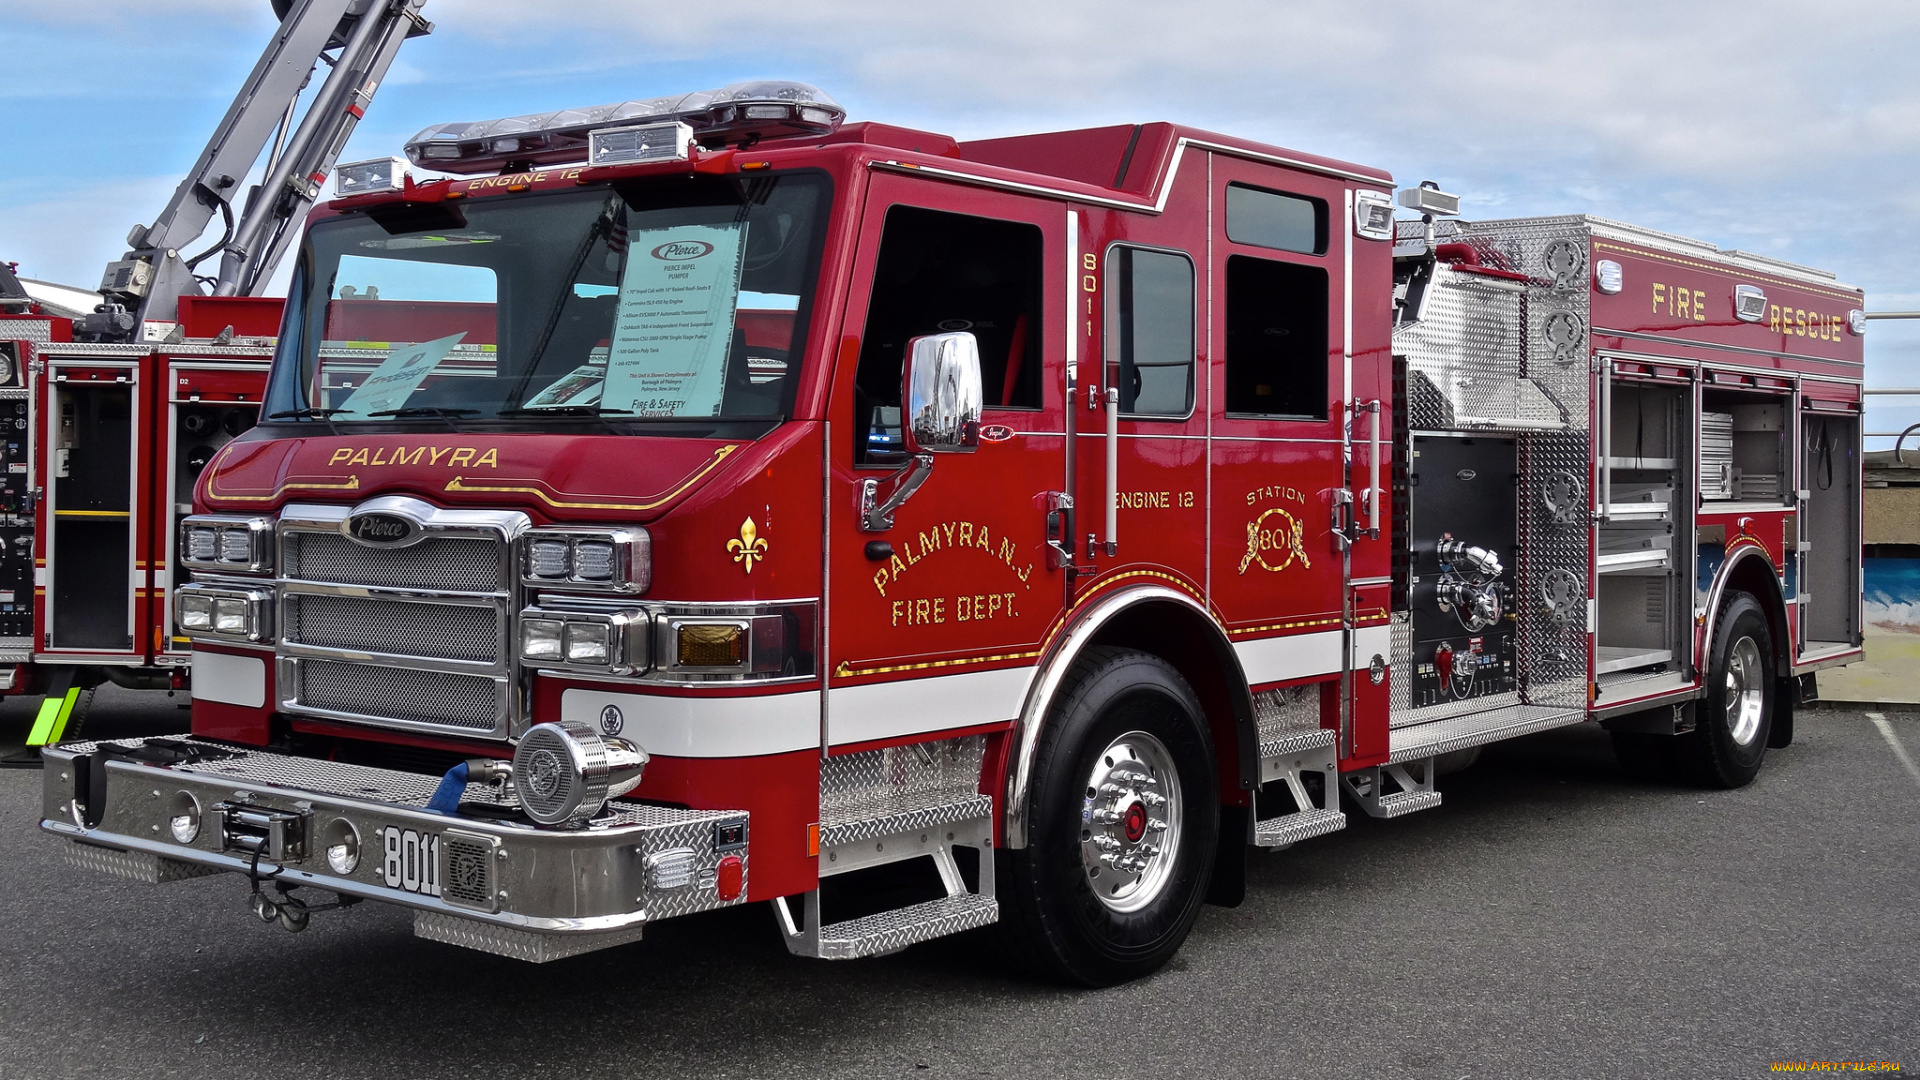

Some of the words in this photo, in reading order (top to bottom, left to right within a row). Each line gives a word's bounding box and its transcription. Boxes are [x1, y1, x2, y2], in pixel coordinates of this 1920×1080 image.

[468, 171, 547, 190] ENGINE
[560, 168, 583, 180] 12
[664, 244, 700, 259] Pierce
[664, 264, 680, 272] PIERCE
[681, 263, 696, 271] IMPEL
[668, 272, 689, 280] PUMPER
[1083, 252, 1097, 337] 8011
[1652, 282, 1706, 322] FIRE
[1770, 304, 1842, 342] RESCUE
[328, 446, 498, 468] PALMYRA
[1178, 491, 1194, 508] 12
[1246, 485, 1306, 506] STATION
[357, 516, 403, 538] Pierce
[1259, 529, 1291, 550] 801
[892, 597, 945, 627] FIRE
[957, 592, 1019, 622] DEPT.
[383, 824, 440, 899] 8011
